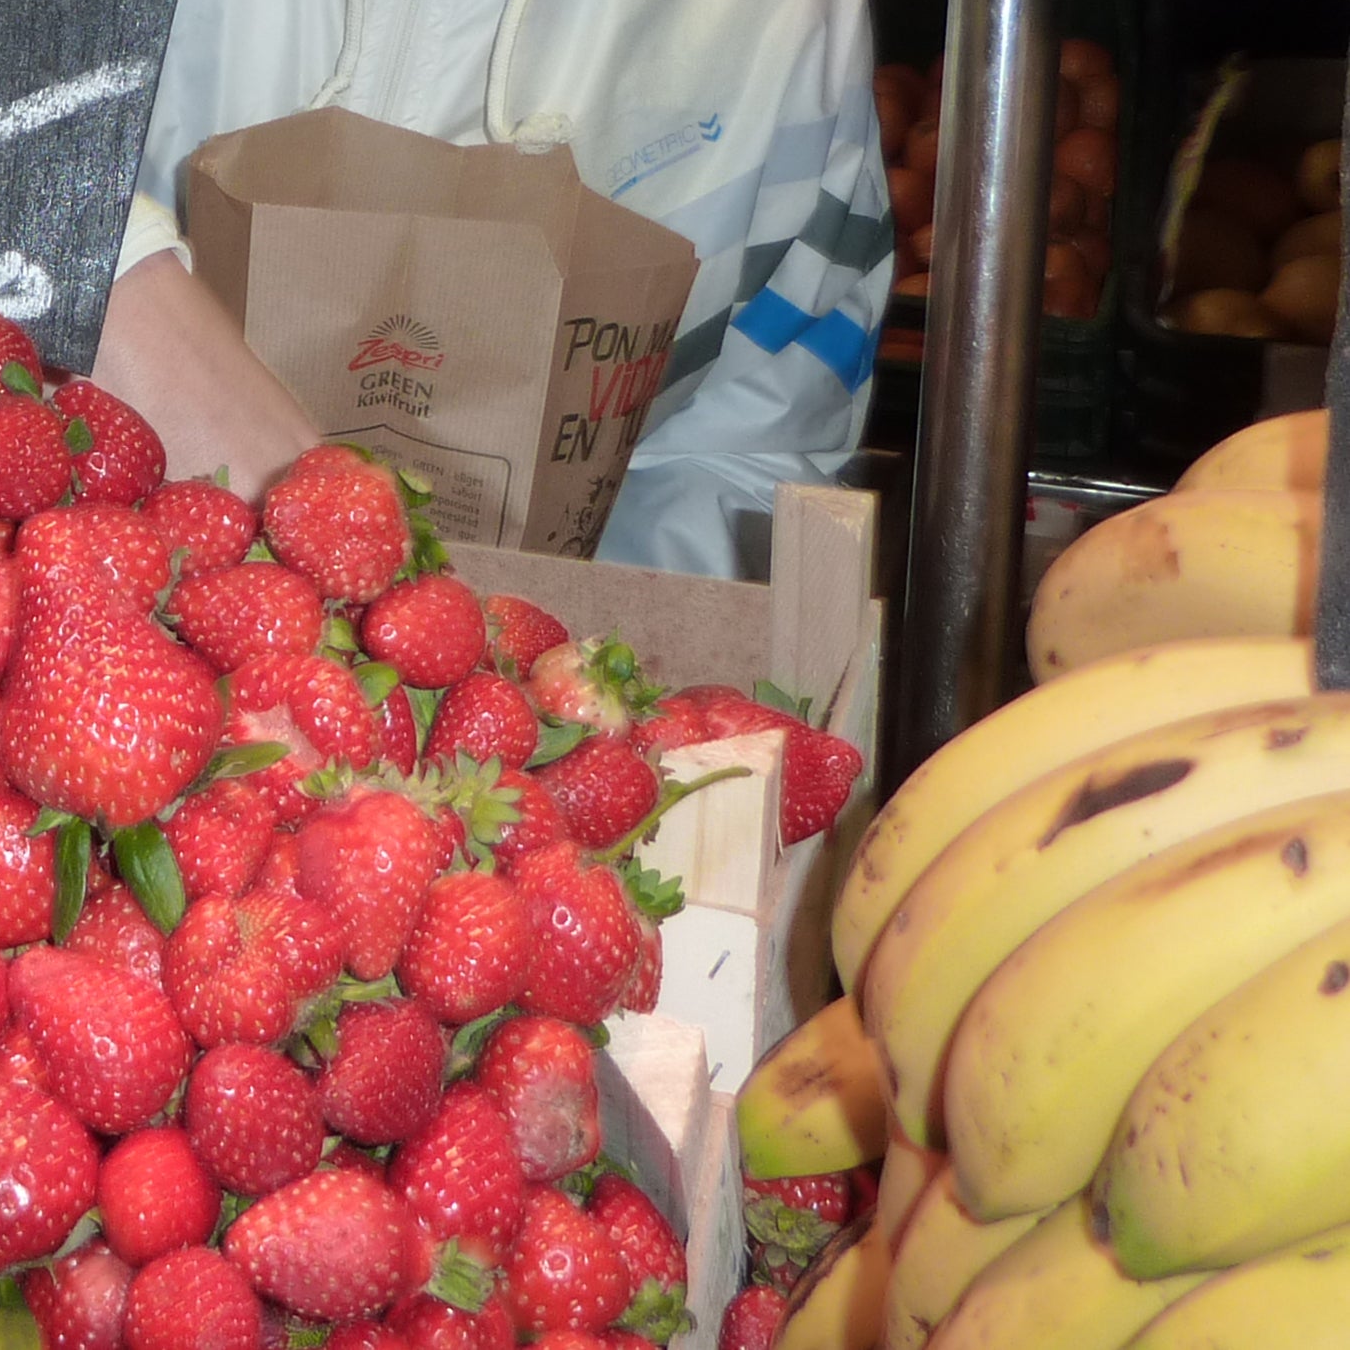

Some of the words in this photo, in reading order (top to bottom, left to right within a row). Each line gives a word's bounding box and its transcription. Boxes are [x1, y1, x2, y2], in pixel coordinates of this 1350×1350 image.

[347, 338, 446, 372] Zespri
[564, 317, 640, 372] PON
[360, 371, 434, 400] GREEN
[356, 389, 433, 419] Kiwifruit
[551, 413, 603, 465] EN
